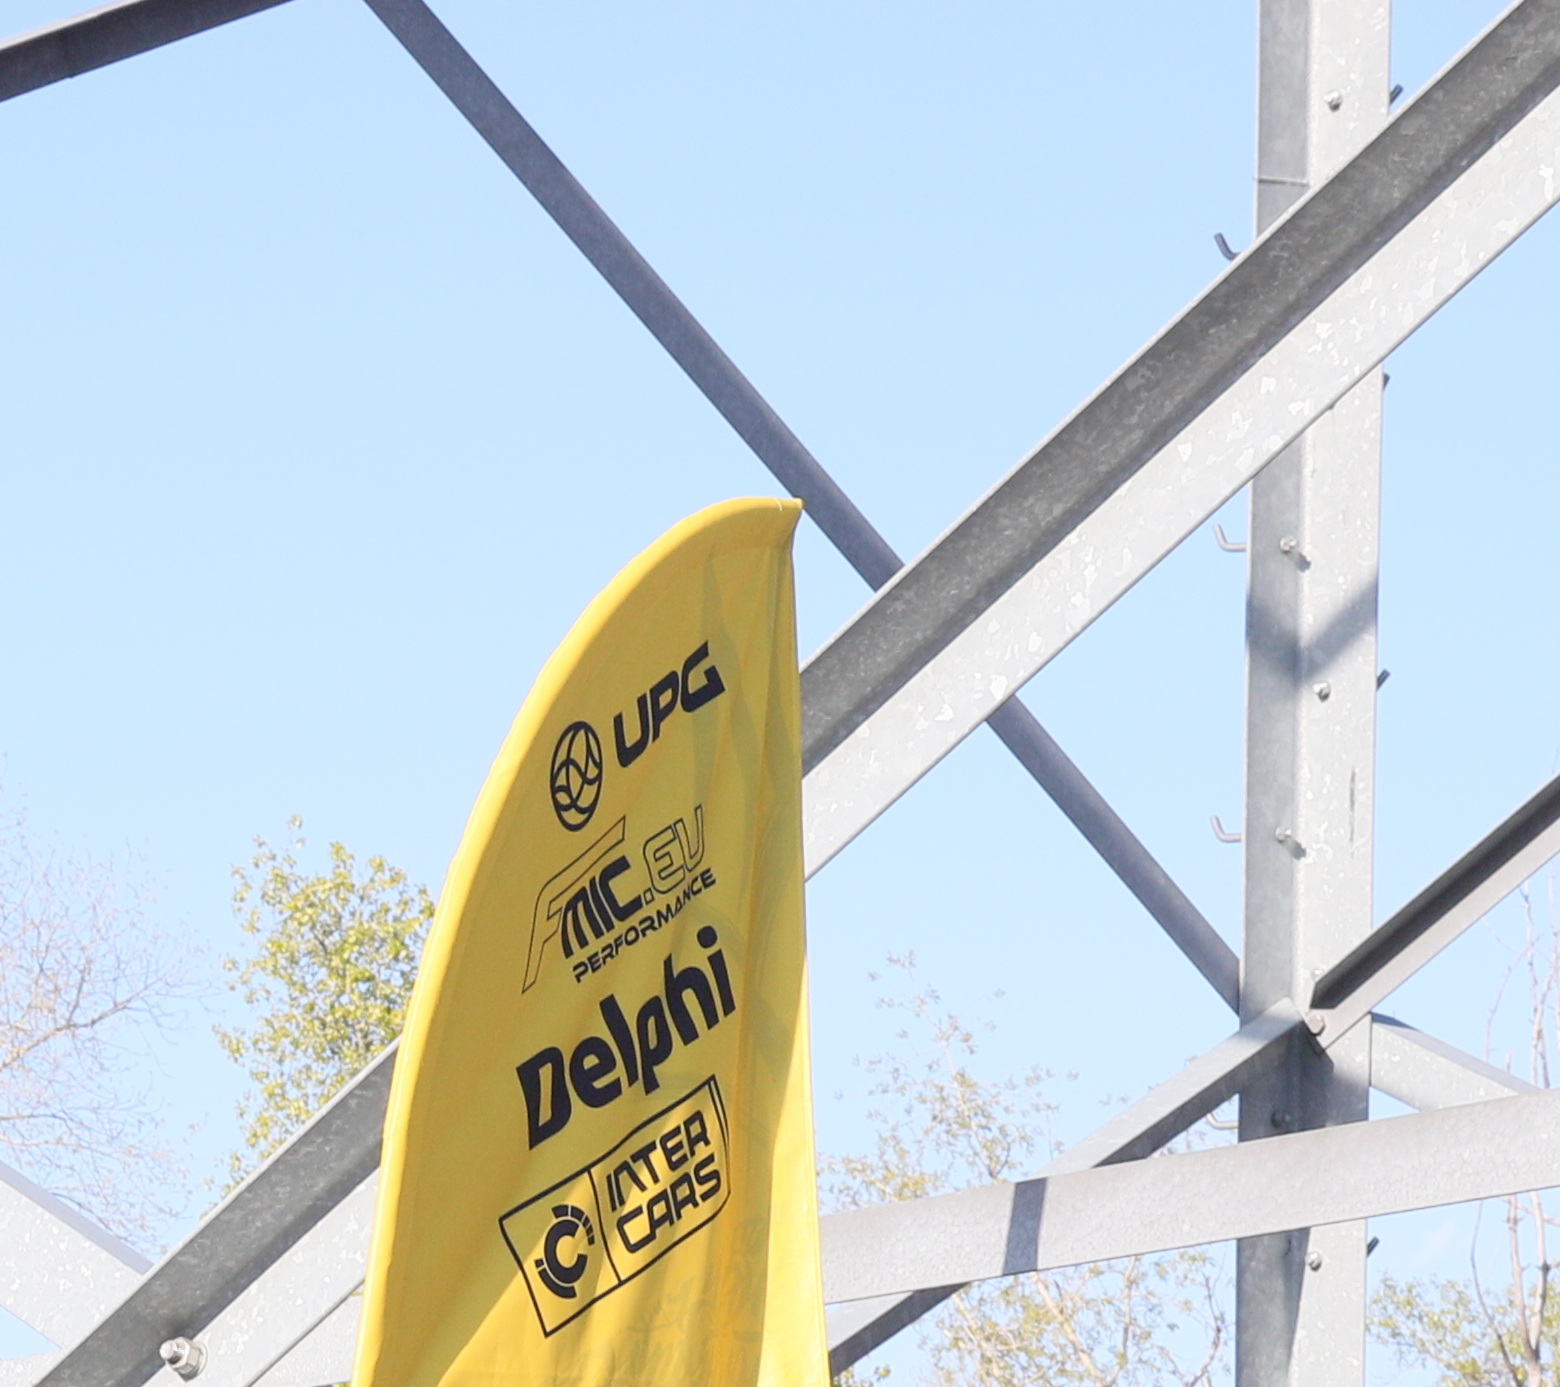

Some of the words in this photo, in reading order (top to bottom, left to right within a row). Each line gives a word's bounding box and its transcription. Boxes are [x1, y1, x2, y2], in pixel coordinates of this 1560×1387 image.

[614, 640, 727, 769] UPG
[572, 867, 717, 984] PERFORMANCE
[516, 926, 737, 1150] Delphi
[606, 1109, 709, 1209] INTER
[616, 1153, 723, 1255] CARS
